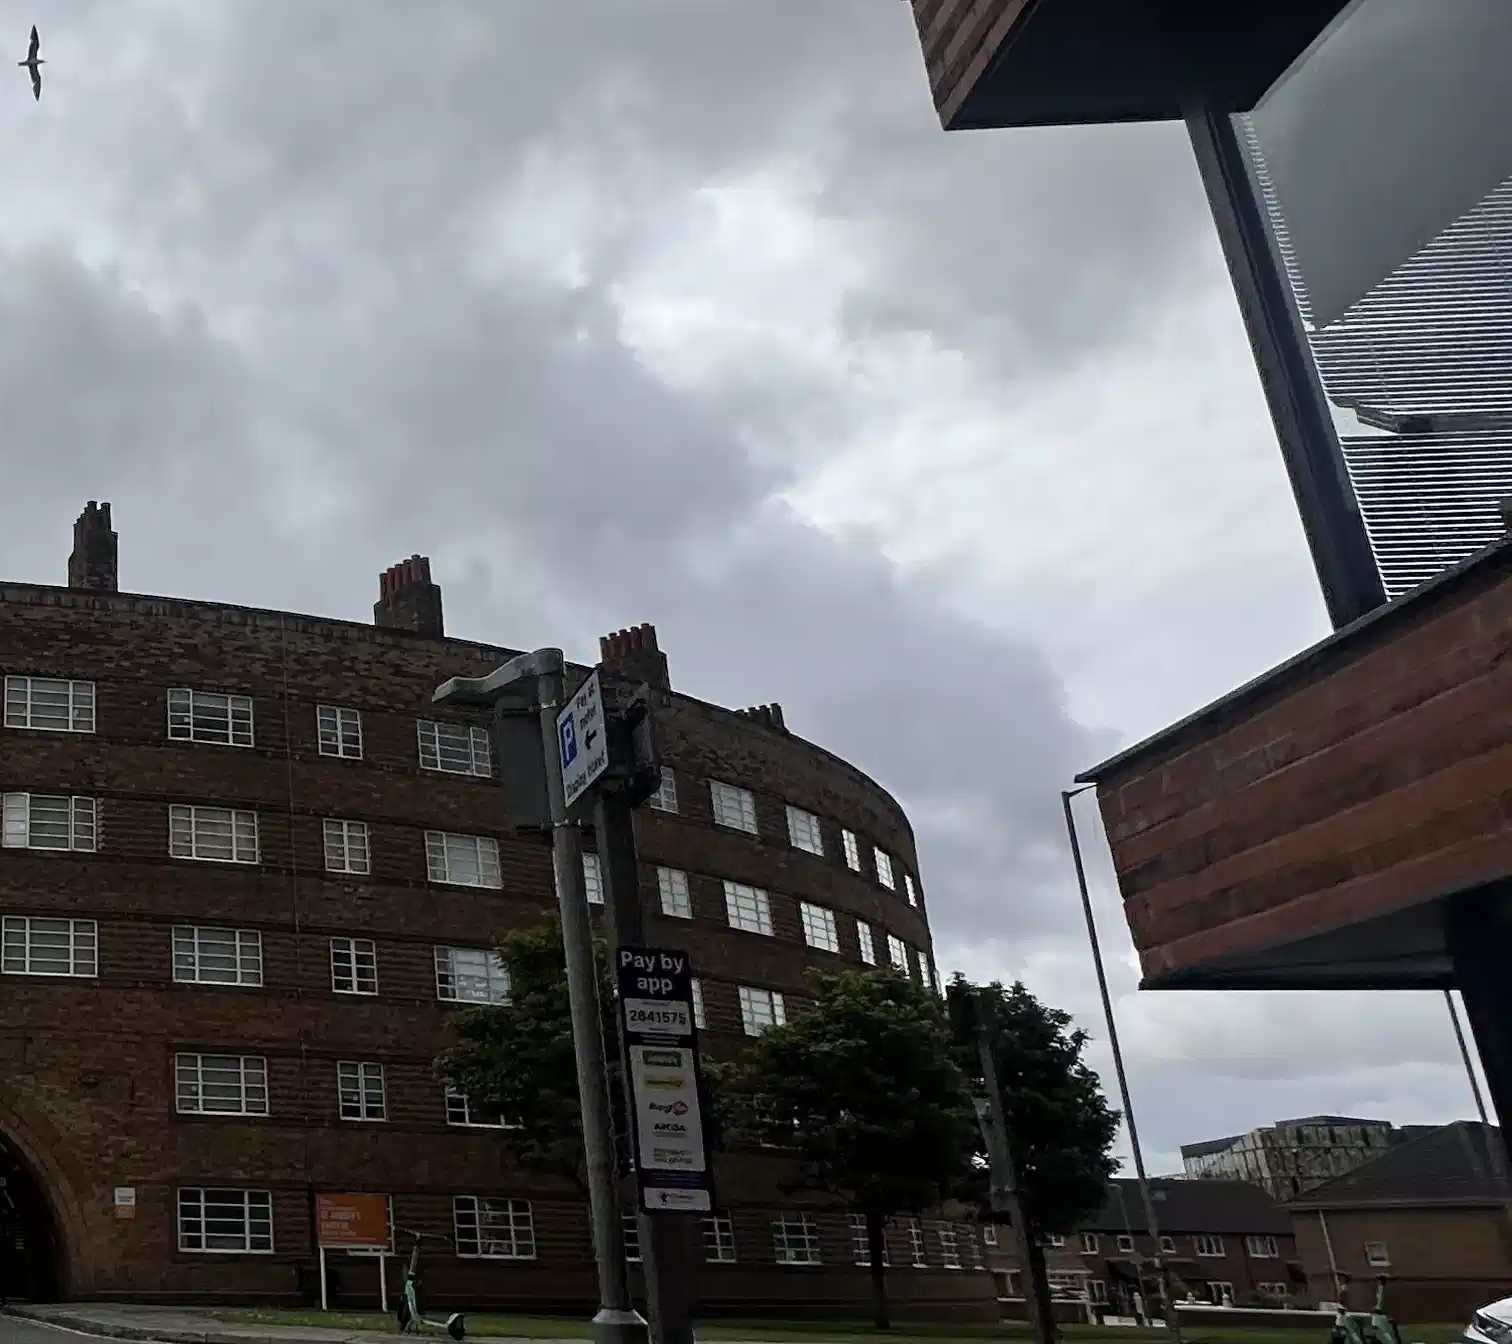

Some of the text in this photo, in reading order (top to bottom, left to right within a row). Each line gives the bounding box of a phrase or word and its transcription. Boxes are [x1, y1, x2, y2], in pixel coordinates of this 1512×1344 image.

[620, 951, 685, 975] Pay by
[636, 976, 673, 996] app
